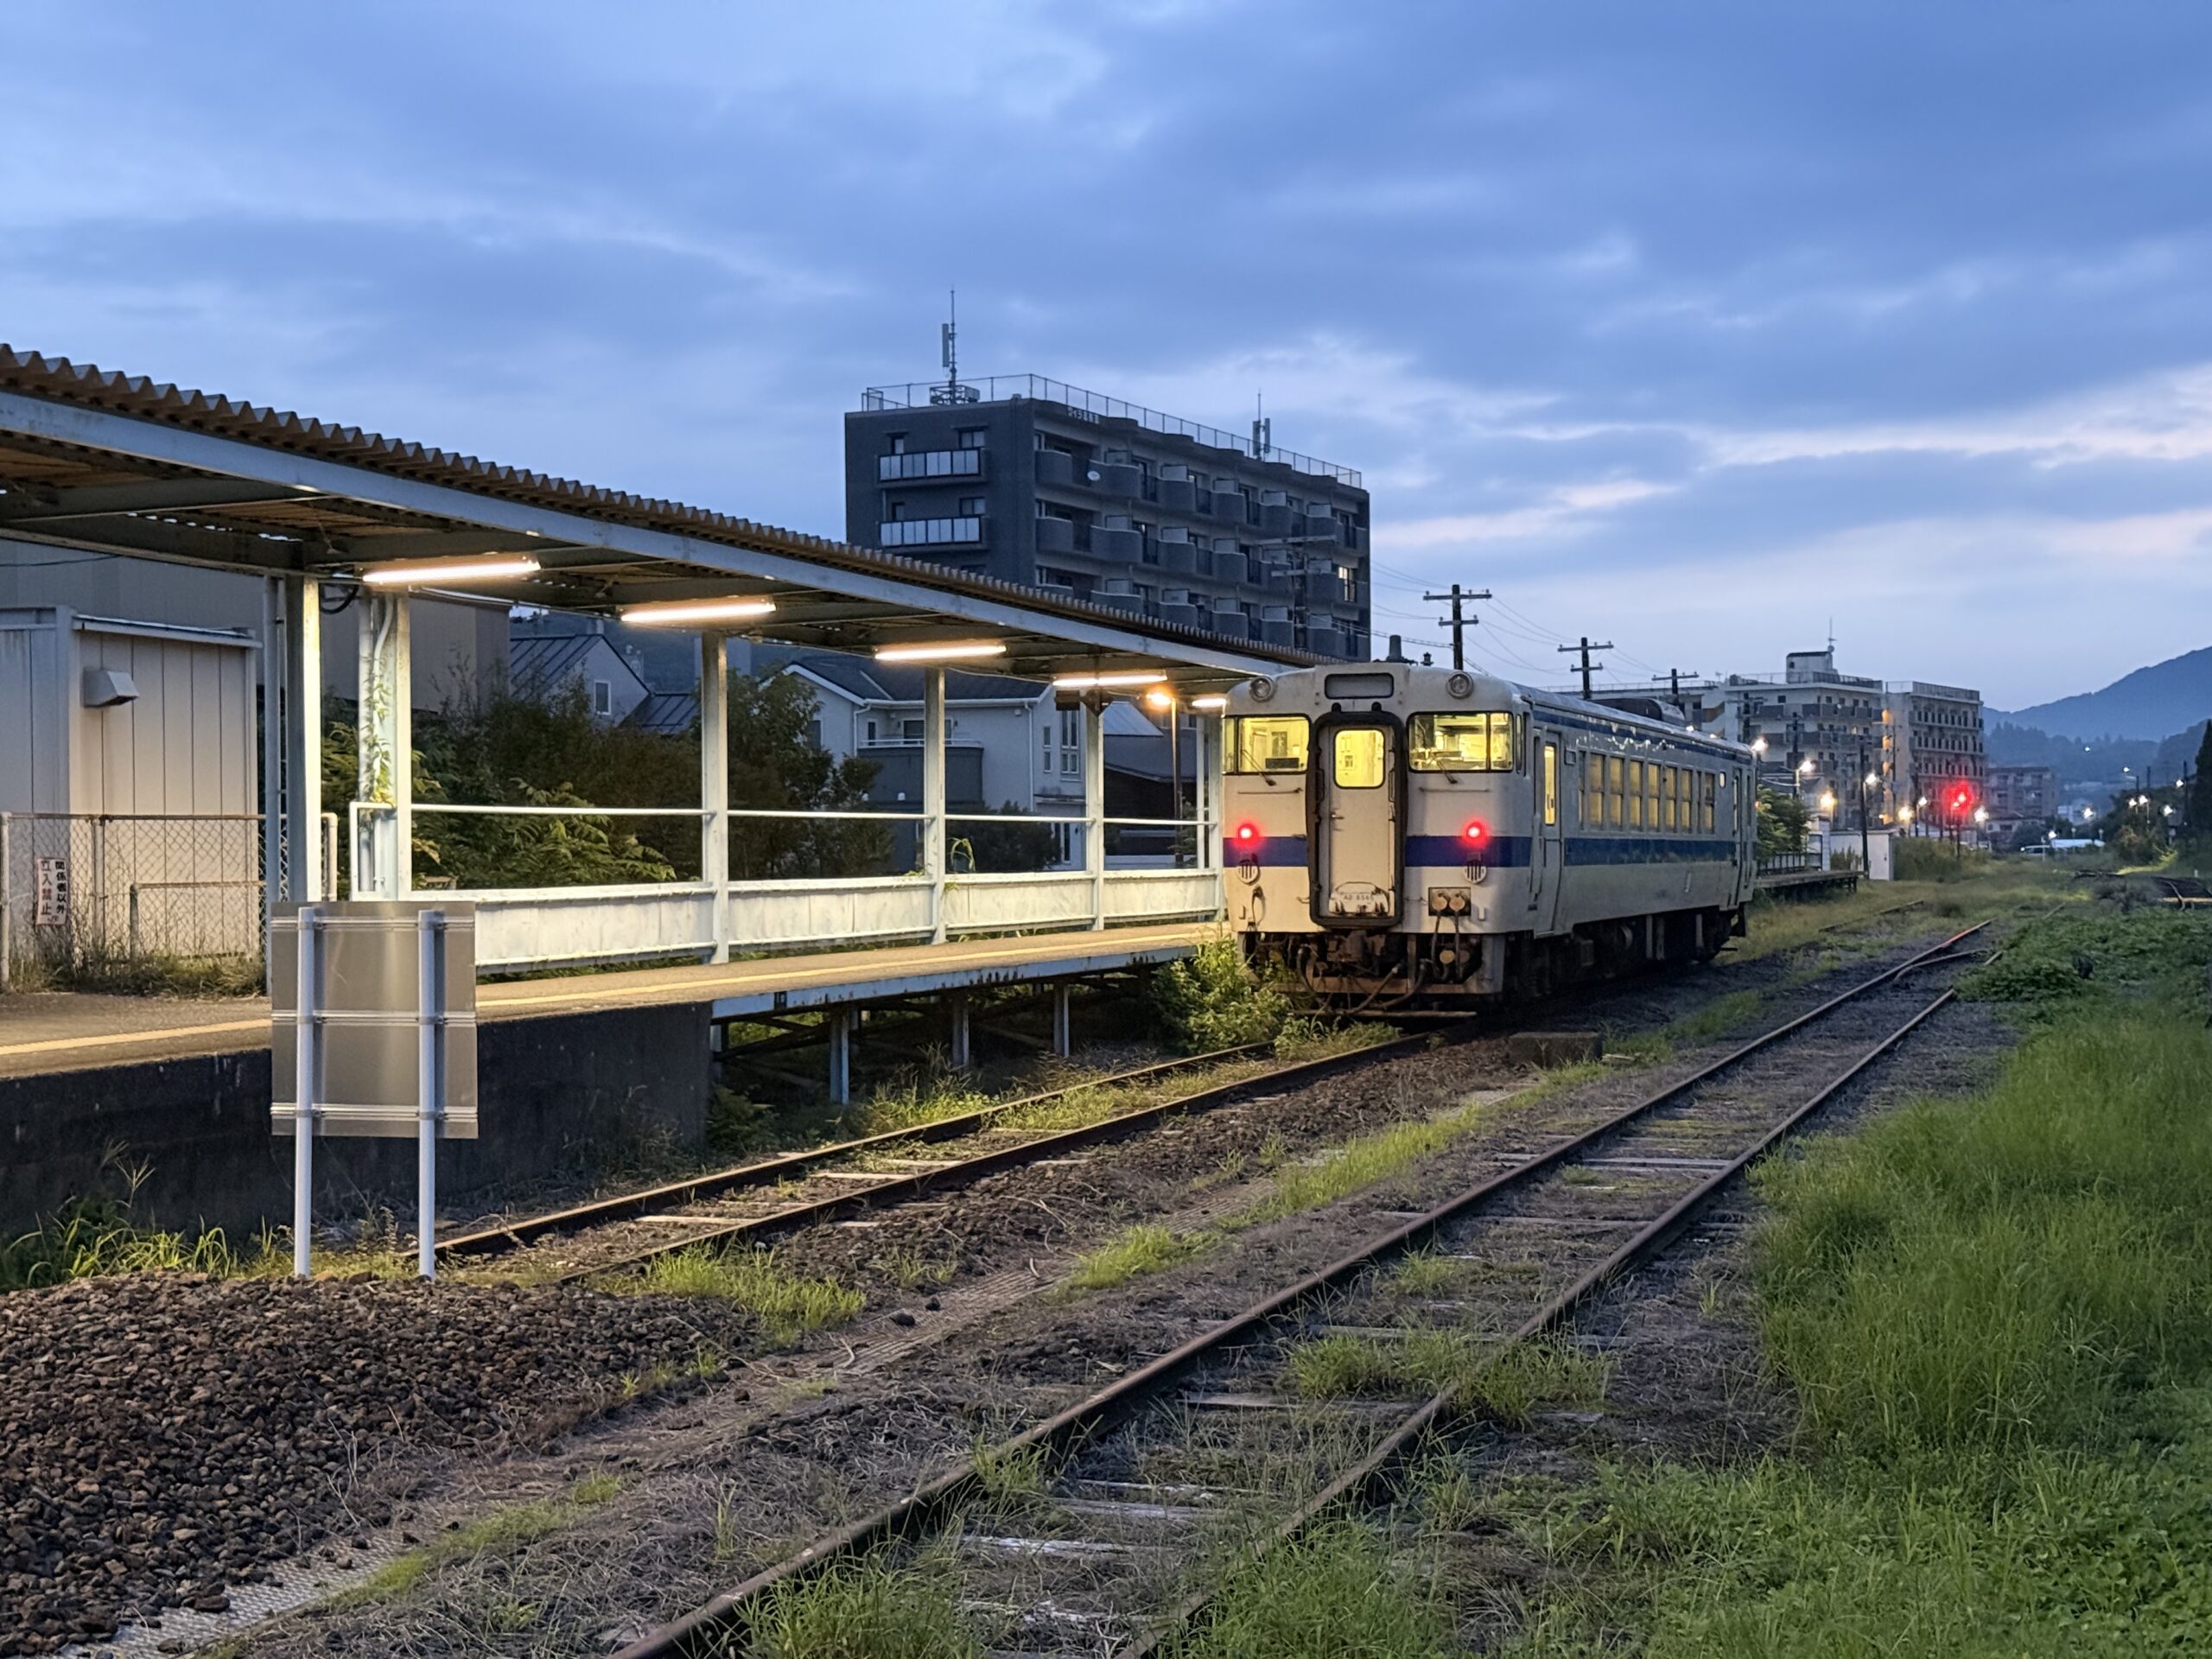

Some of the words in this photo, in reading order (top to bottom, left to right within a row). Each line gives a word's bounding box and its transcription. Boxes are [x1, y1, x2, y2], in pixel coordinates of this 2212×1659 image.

[41, 860, 52, 915] 立入禁止
[55, 861, 67, 914] 関係者以外
